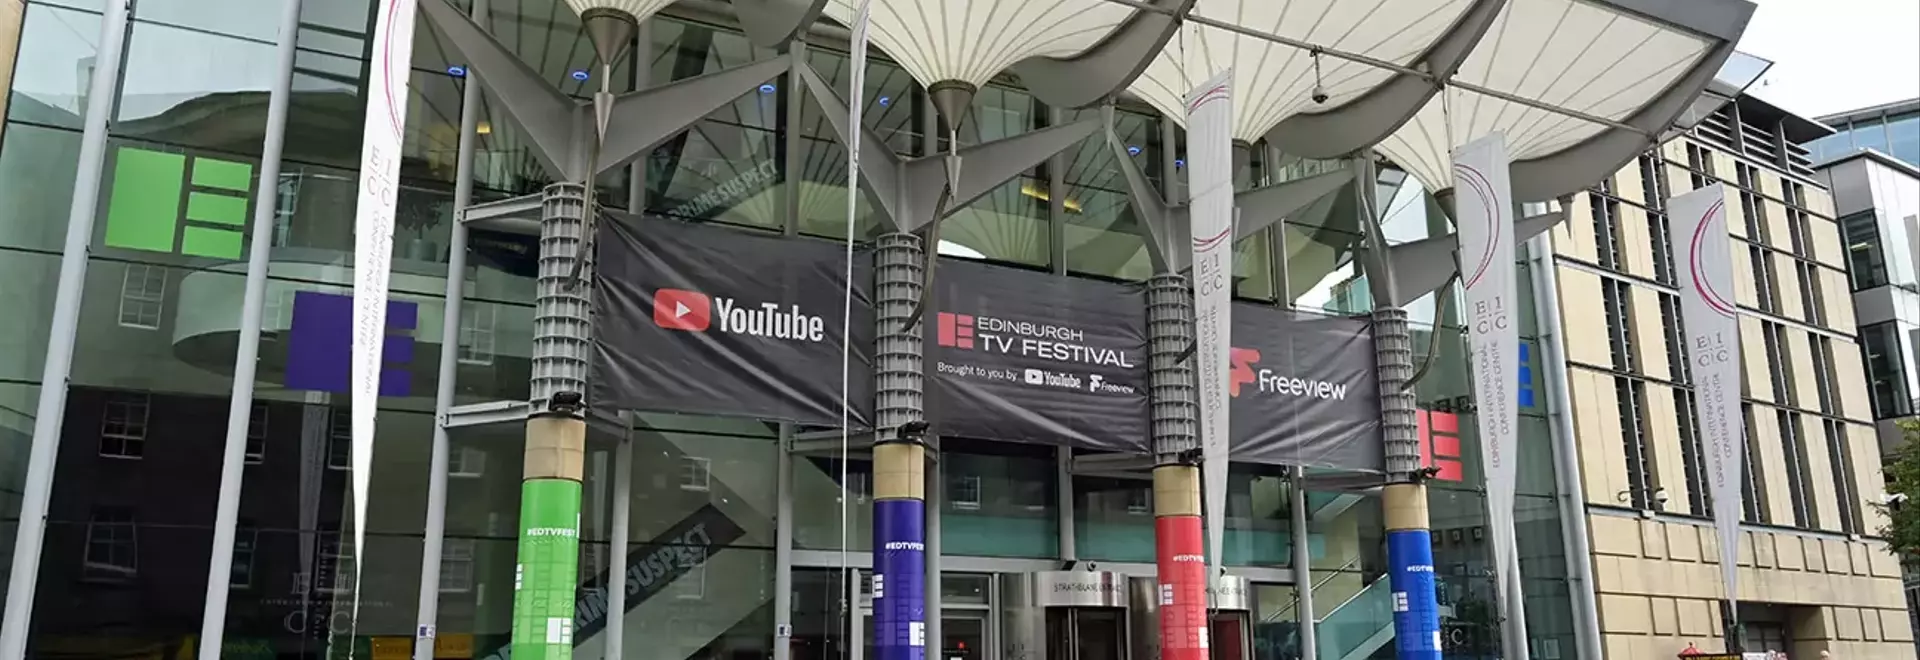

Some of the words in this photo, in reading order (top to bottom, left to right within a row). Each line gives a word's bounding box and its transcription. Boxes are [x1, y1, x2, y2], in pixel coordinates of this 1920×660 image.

[715, 297, 824, 342] YouTube
[1475, 300, 1487, 315] E
[978, 316, 1084, 342] EDINBURGH
[1476, 320, 1489, 335] C
[1495, 315, 1508, 330] C
[978, 333, 1014, 354] TV
[1022, 339, 1134, 368] FESTIVAL
[1696, 336, 1708, 350] E
[1698, 354, 1710, 367] C
[1717, 349, 1729, 363] C
[937, 361, 974, 376] Brought
[975, 366, 986, 376] to
[987, 370, 1004, 379] you
[1006, 369, 1018, 382] by
[1044, 371, 1081, 388] YouTube
[1101, 382, 1135, 394] Freeview
[1259, 369, 1346, 400] Freeview
[625, 523, 712, 596] SUSPECT
